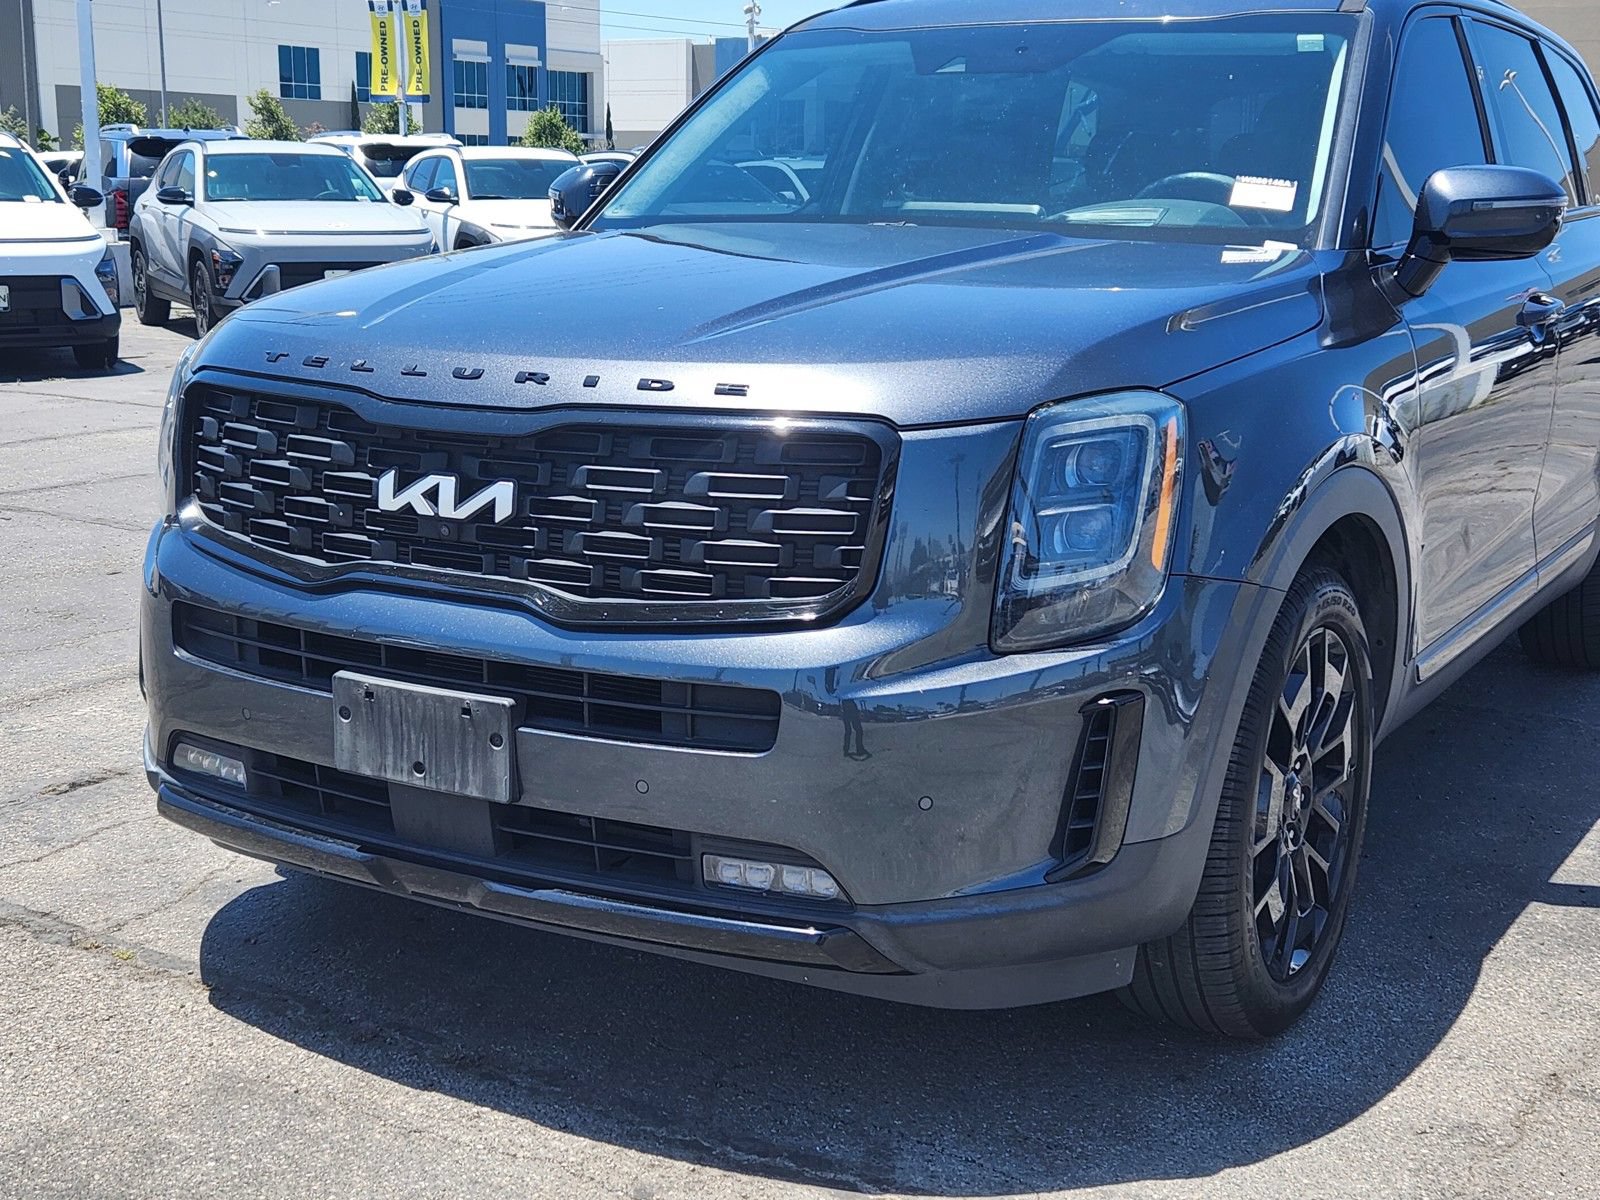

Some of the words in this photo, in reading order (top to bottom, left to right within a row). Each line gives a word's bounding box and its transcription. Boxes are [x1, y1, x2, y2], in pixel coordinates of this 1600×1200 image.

[379, 20, 389, 92] PRE-OWNED
[412, 19, 423, 92] PRE-OWNED
[264, 350, 750, 397] TELLURIDE
[378, 469, 514, 523] KIA
